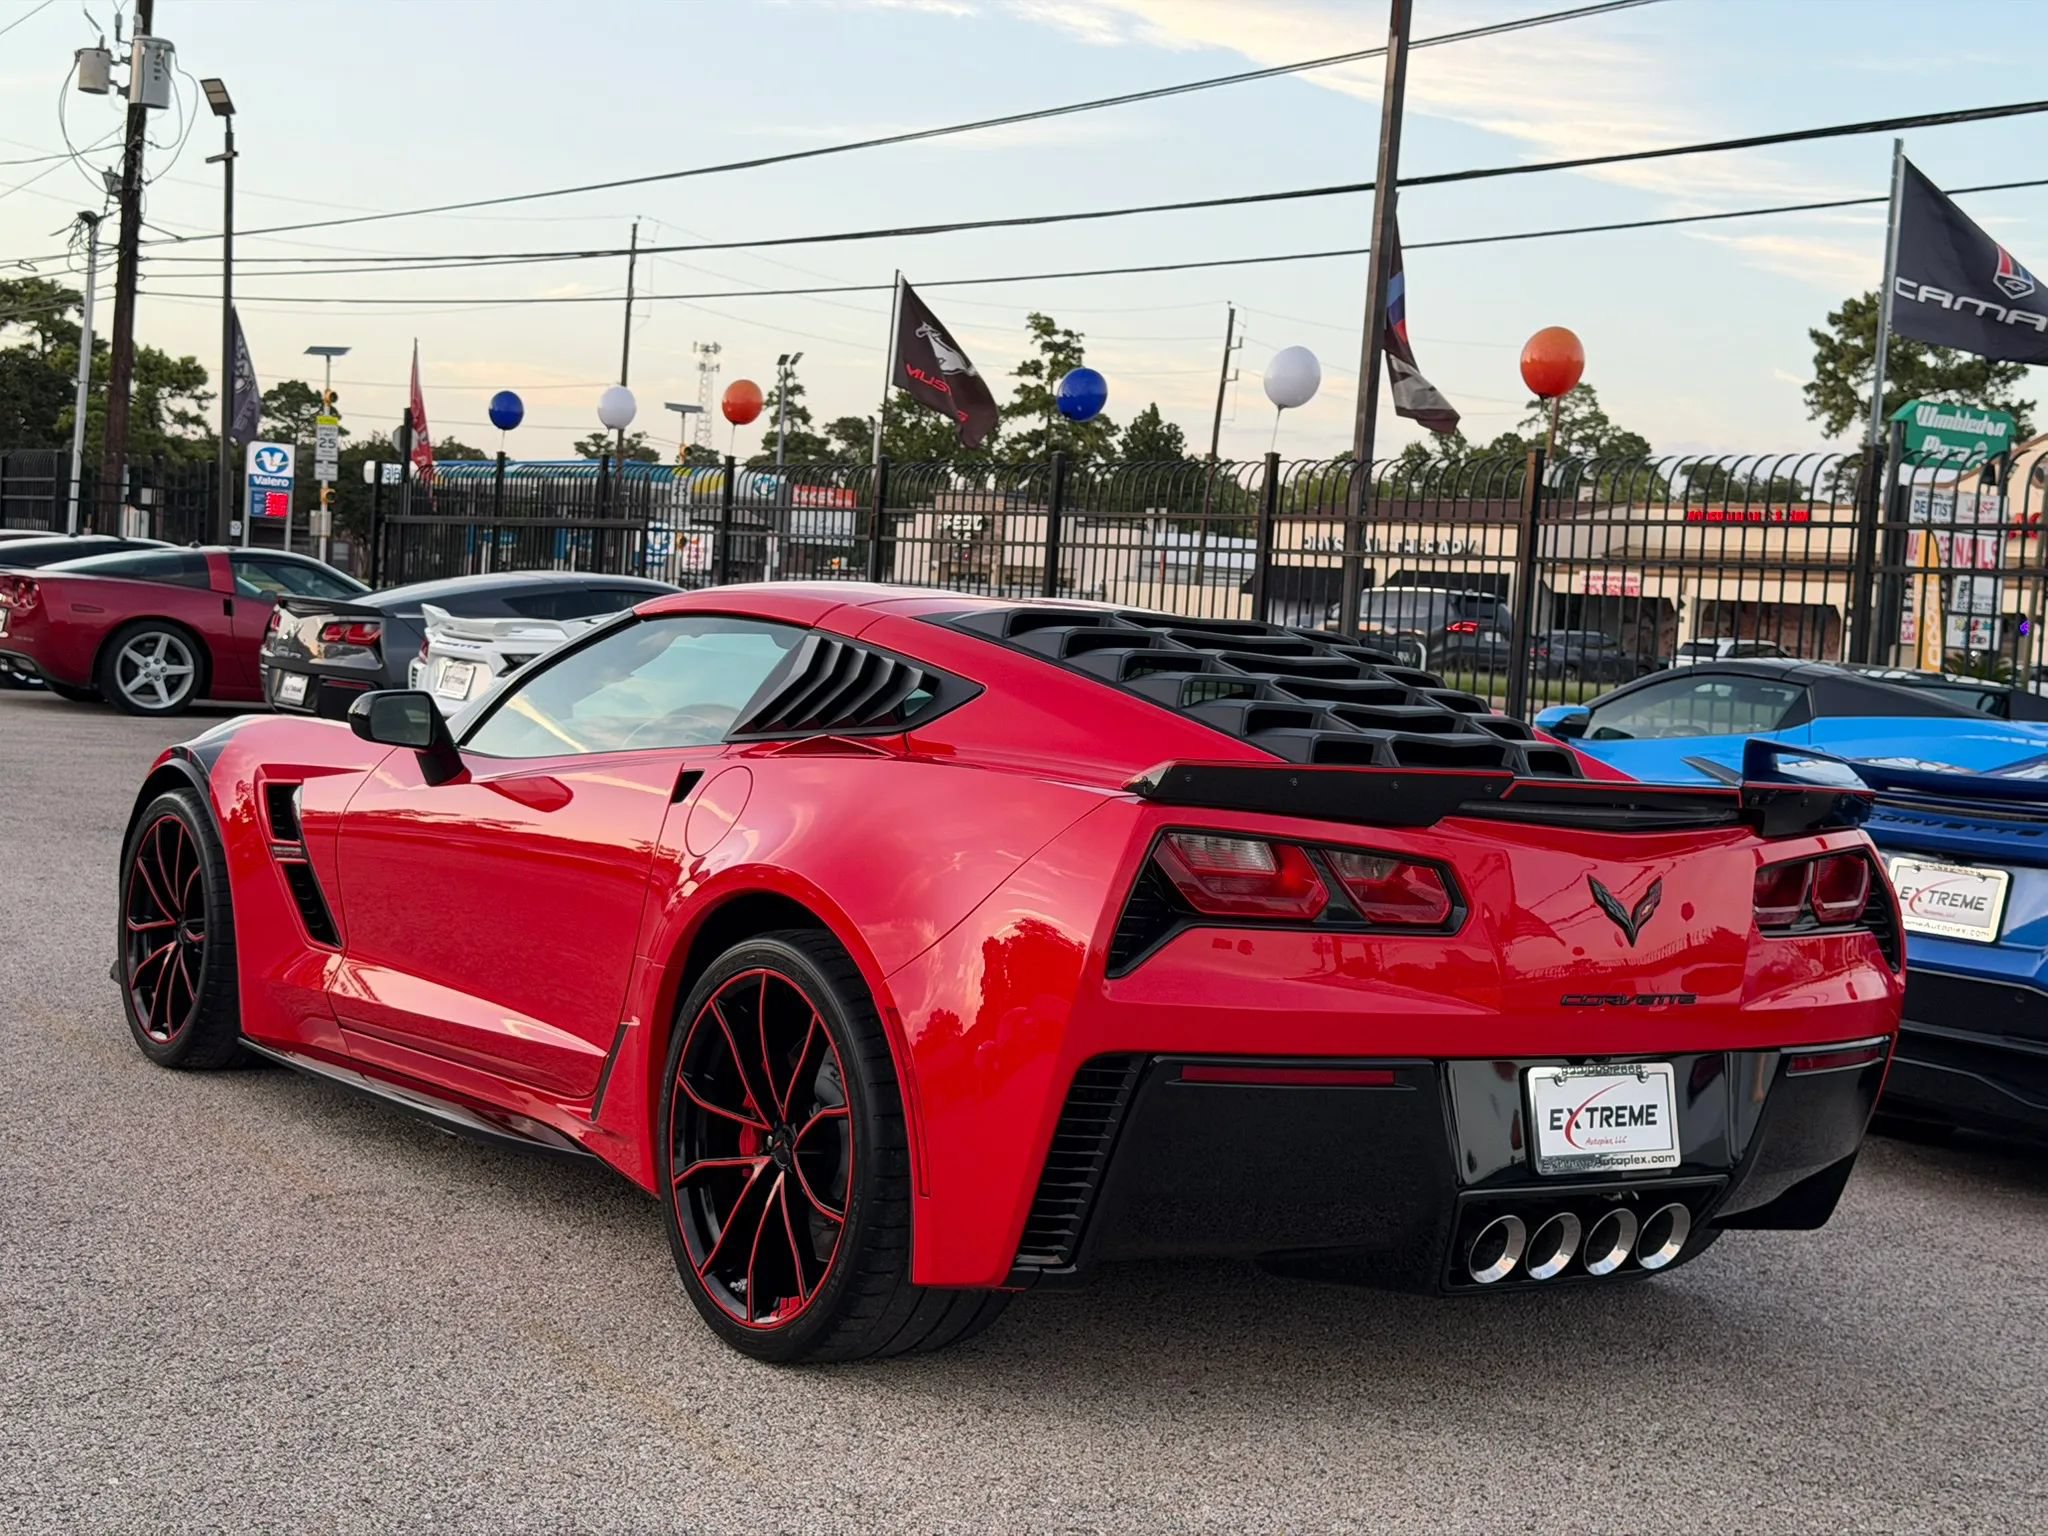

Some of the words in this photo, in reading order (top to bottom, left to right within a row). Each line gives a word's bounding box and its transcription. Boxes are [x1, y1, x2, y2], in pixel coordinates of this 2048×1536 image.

[1916, 404, 2007, 437] Wimbledon
[319, 437, 337, 449] 25
[1921, 434, 1971, 463] Plaza
[253, 475, 289, 487] Valero
[1913, 499, 1952, 517] DETIST
[1303, 537, 1378, 554] PHYSAL
[1955, 535, 1997, 570] NAILS
[1900, 886, 1987, 911] EXTREME
[1561, 993, 1697, 1007] CORVETTE
[1550, 1104, 1658, 1131] EXTREME
